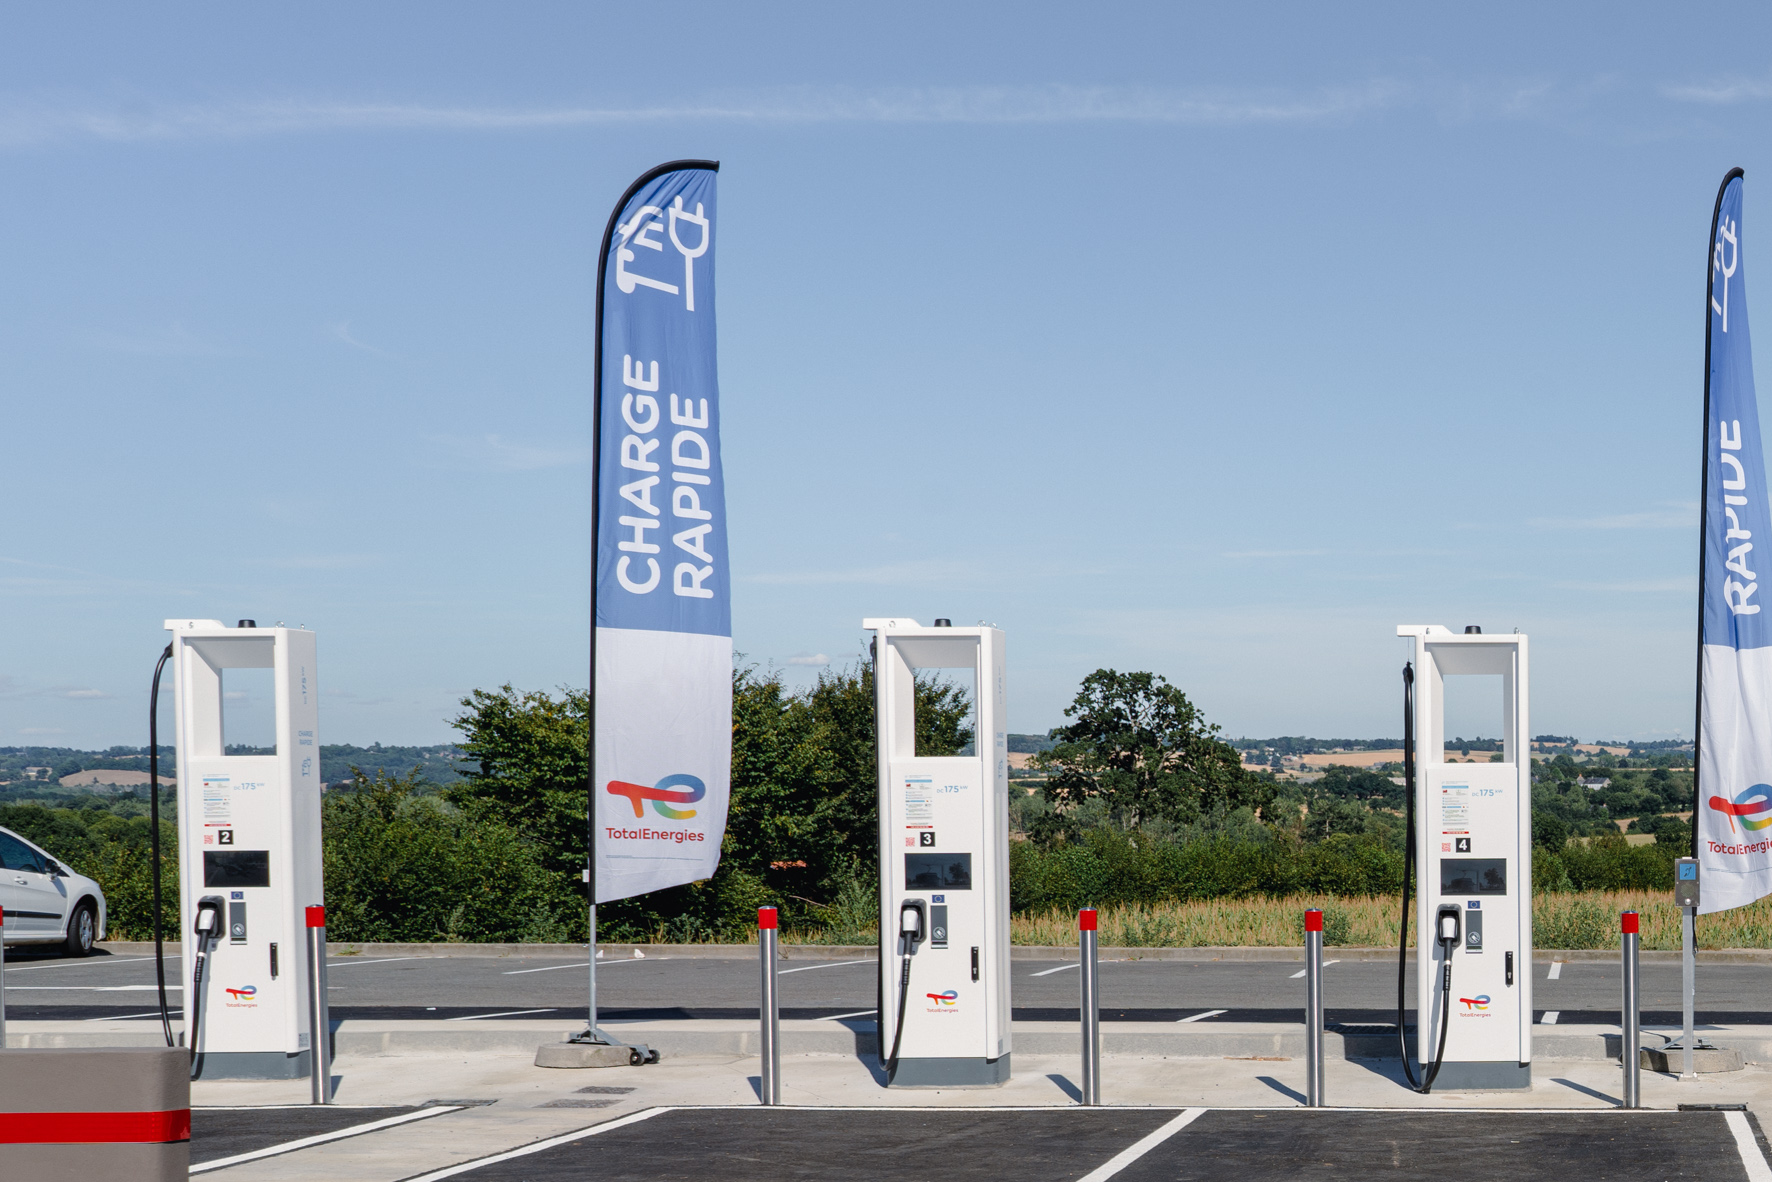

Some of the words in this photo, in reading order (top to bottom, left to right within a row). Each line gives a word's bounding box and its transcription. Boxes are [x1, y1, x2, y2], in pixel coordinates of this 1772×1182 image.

[616, 354, 661, 595] CHARGE
[670, 393, 714, 599] RAPIDE
[1720, 419, 1761, 616] RAPIDE
[944, 785, 960, 793] 175
[1479, 789, 1495, 797] 175
[221, 831, 231, 843] 2
[605, 827, 705, 844] TotalEnergies
[923, 833, 932, 845] 3
[1458, 838, 1468, 851] 4
